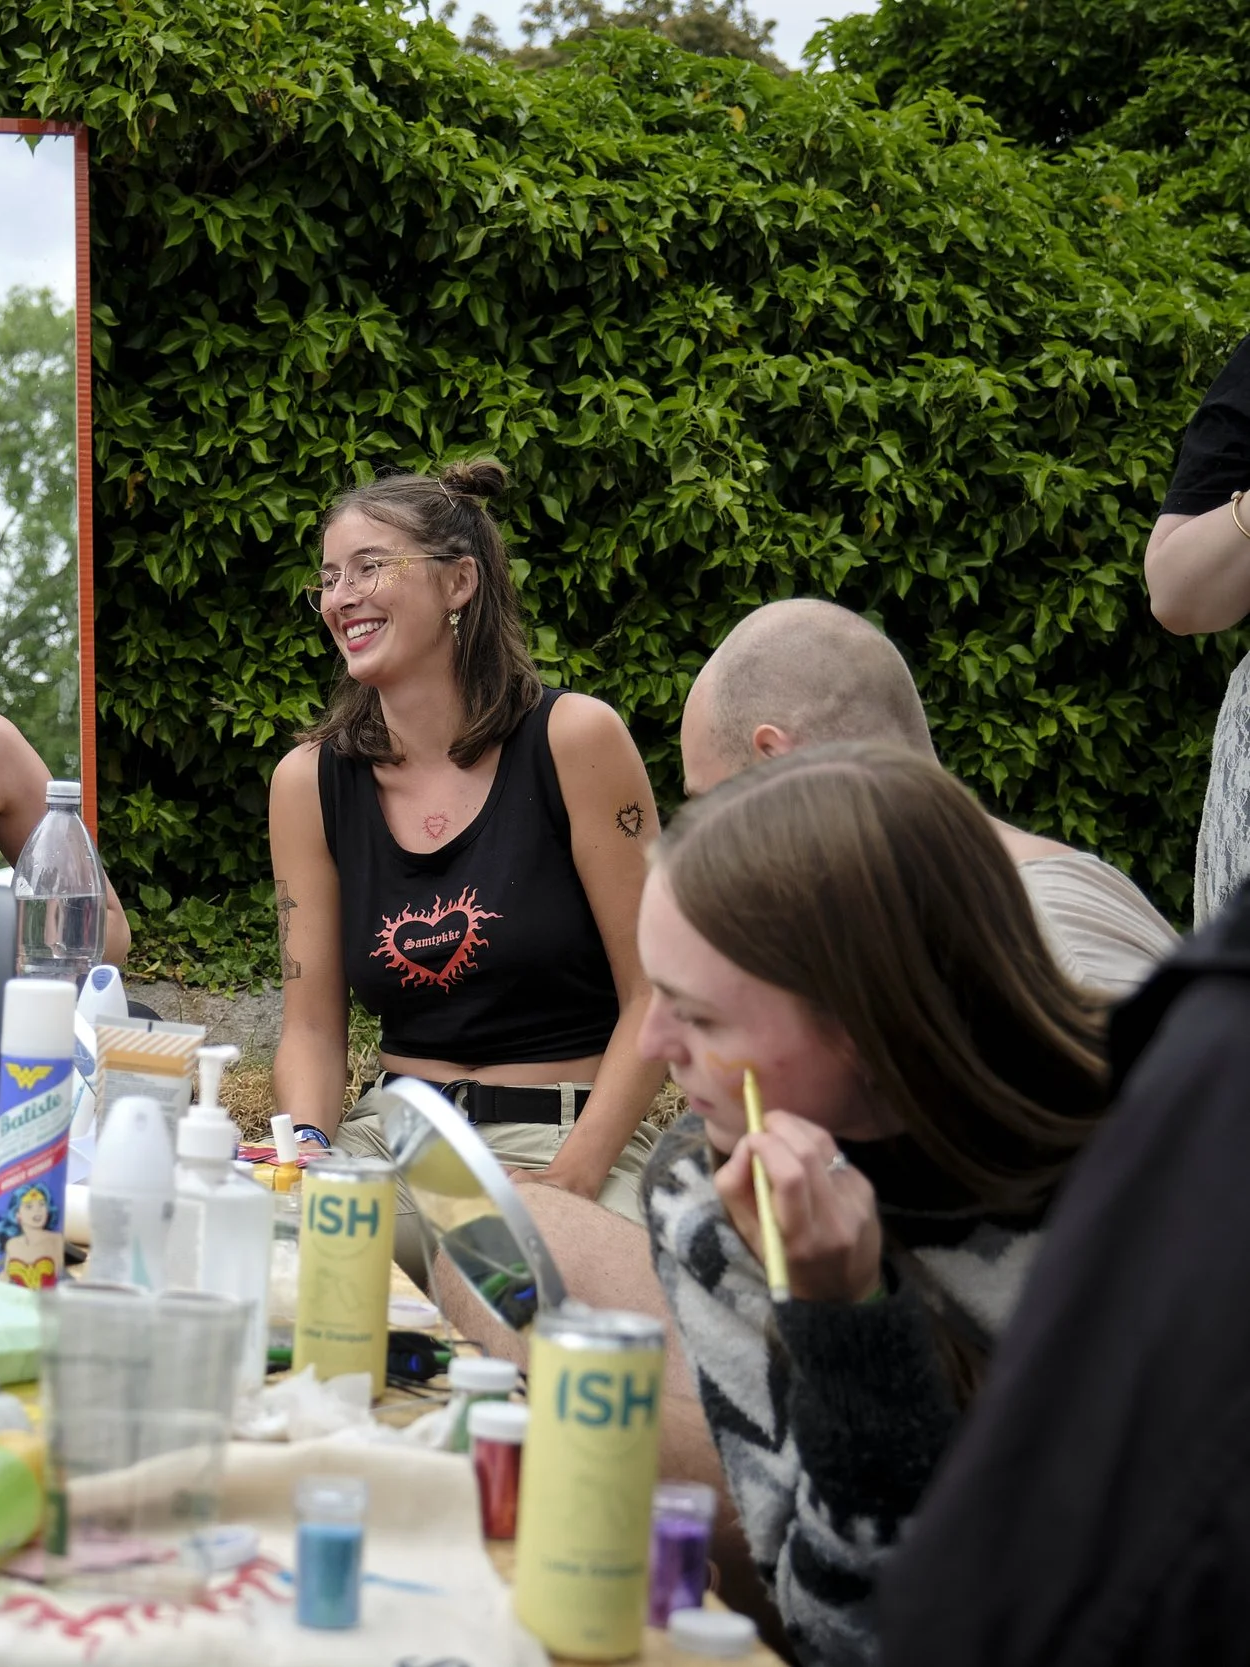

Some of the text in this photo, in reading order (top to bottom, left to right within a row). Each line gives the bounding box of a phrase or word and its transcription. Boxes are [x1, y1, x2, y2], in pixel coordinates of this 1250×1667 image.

[403, 930, 461, 951] Samtykke
[308, 1193, 380, 1238] ISH
[555, 1367, 659, 1432] ISH
